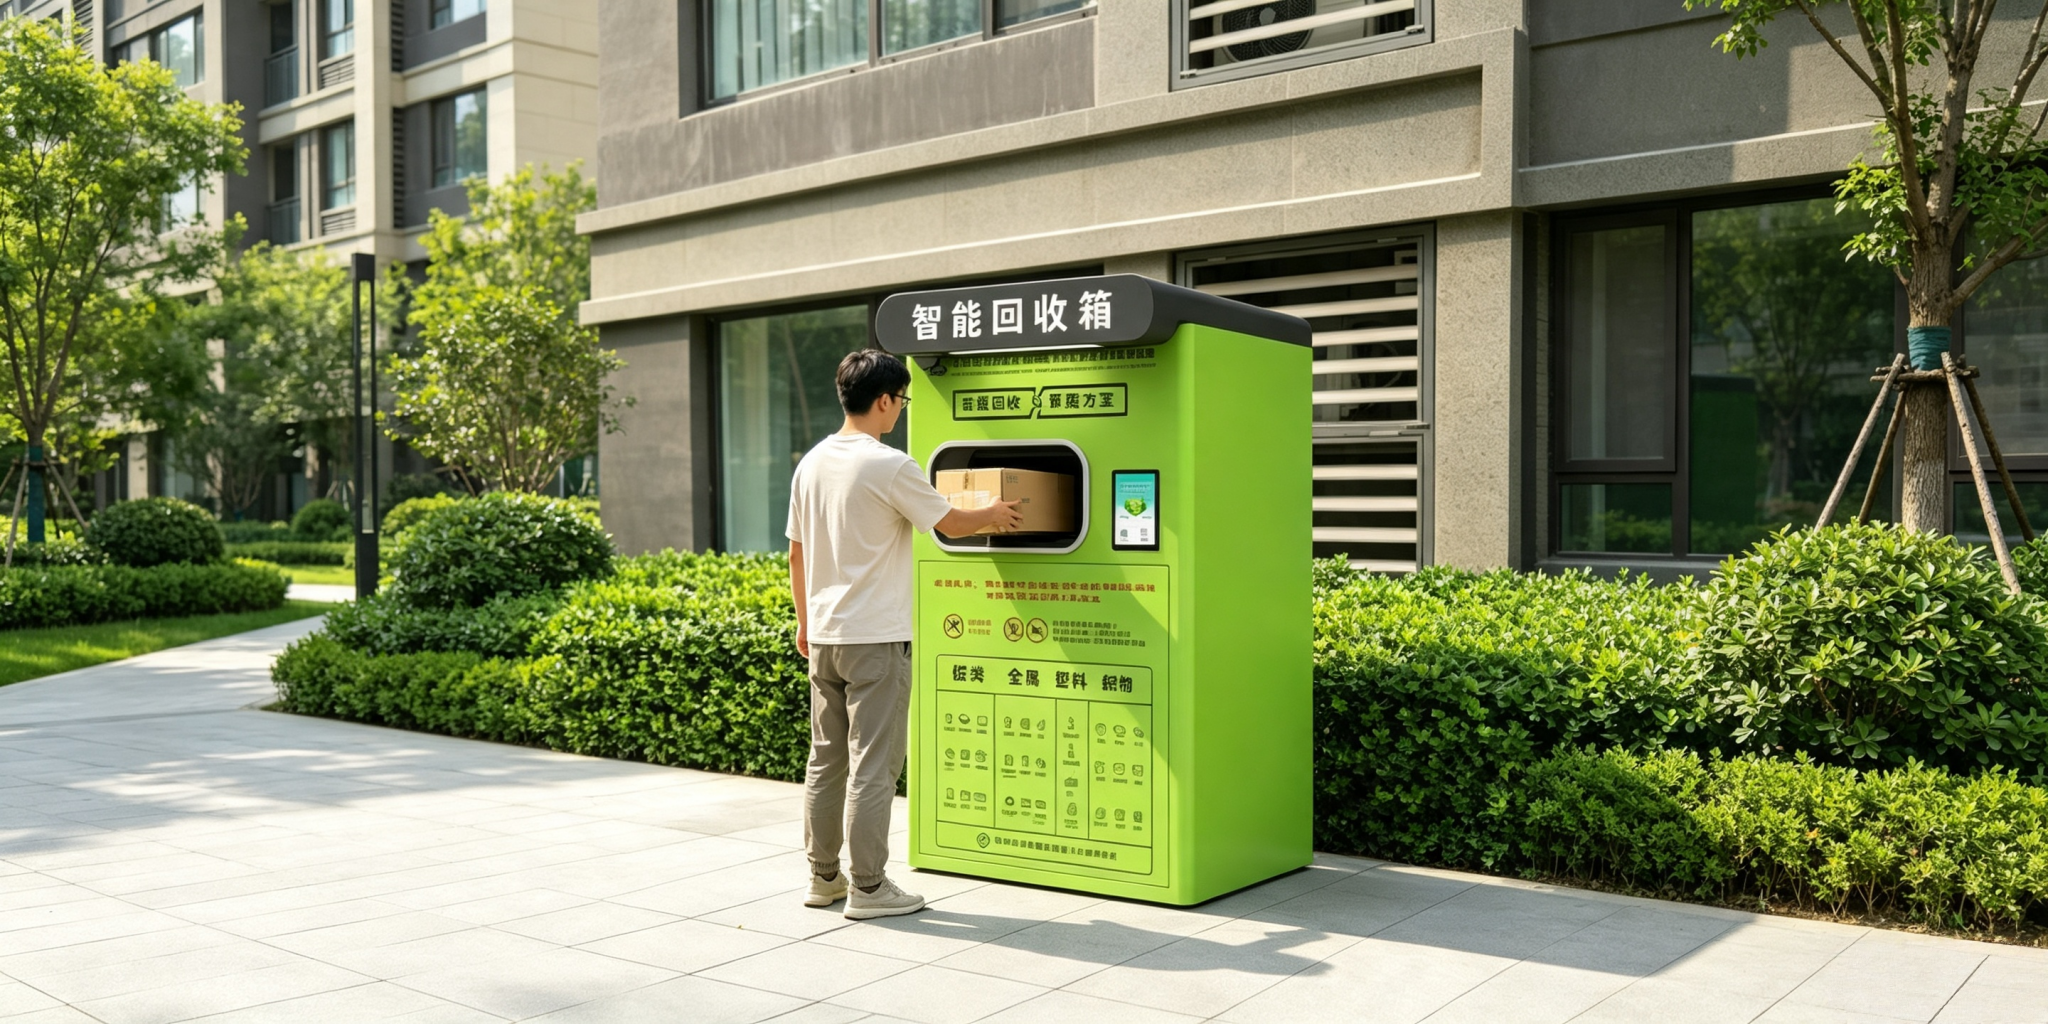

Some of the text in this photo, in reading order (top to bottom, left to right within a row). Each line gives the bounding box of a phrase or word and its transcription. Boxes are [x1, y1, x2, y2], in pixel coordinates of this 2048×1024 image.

[911, 289, 1113, 341] 智能回收箱
